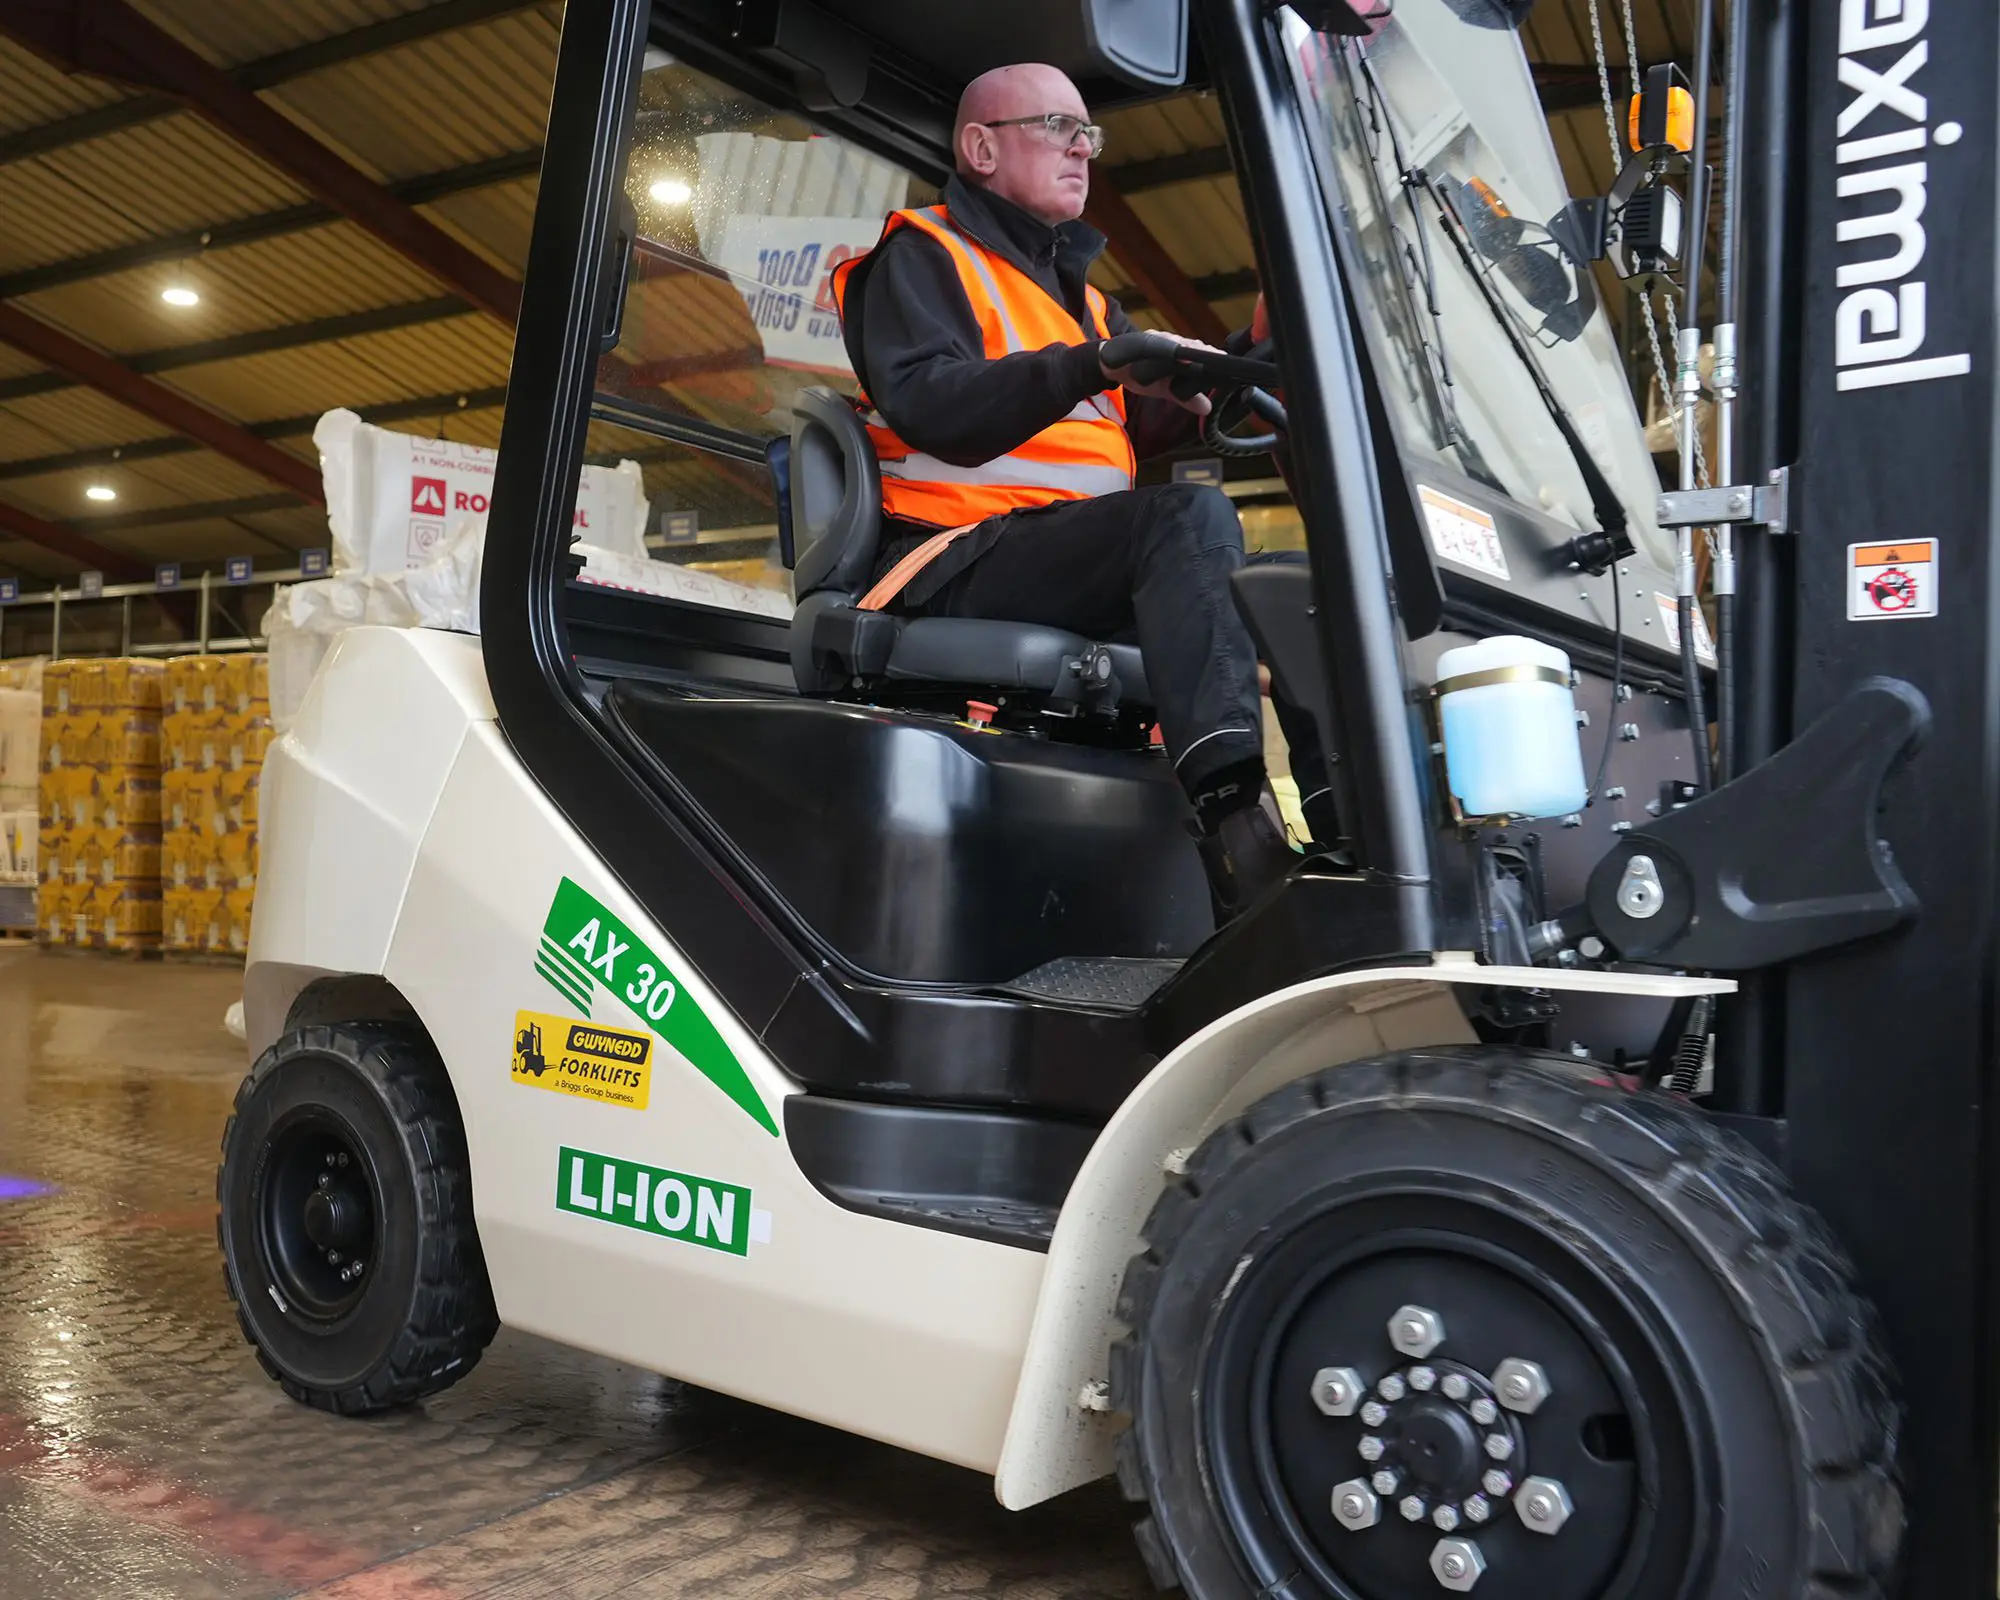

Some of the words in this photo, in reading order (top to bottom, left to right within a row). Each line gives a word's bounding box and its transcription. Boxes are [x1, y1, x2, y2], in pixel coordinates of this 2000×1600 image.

[567, 917, 630, 982] AX
[626, 963, 676, 1021] 30
[573, 1031, 643, 1058] GWYNEDD
[558, 1057, 641, 1088] FORKLIFTS
[560, 1080, 581, 1093] Briggs
[582, 1084, 604, 1098] Group
[605, 1089, 634, 1103] business
[569, 1156, 735, 1245] LI-ION
